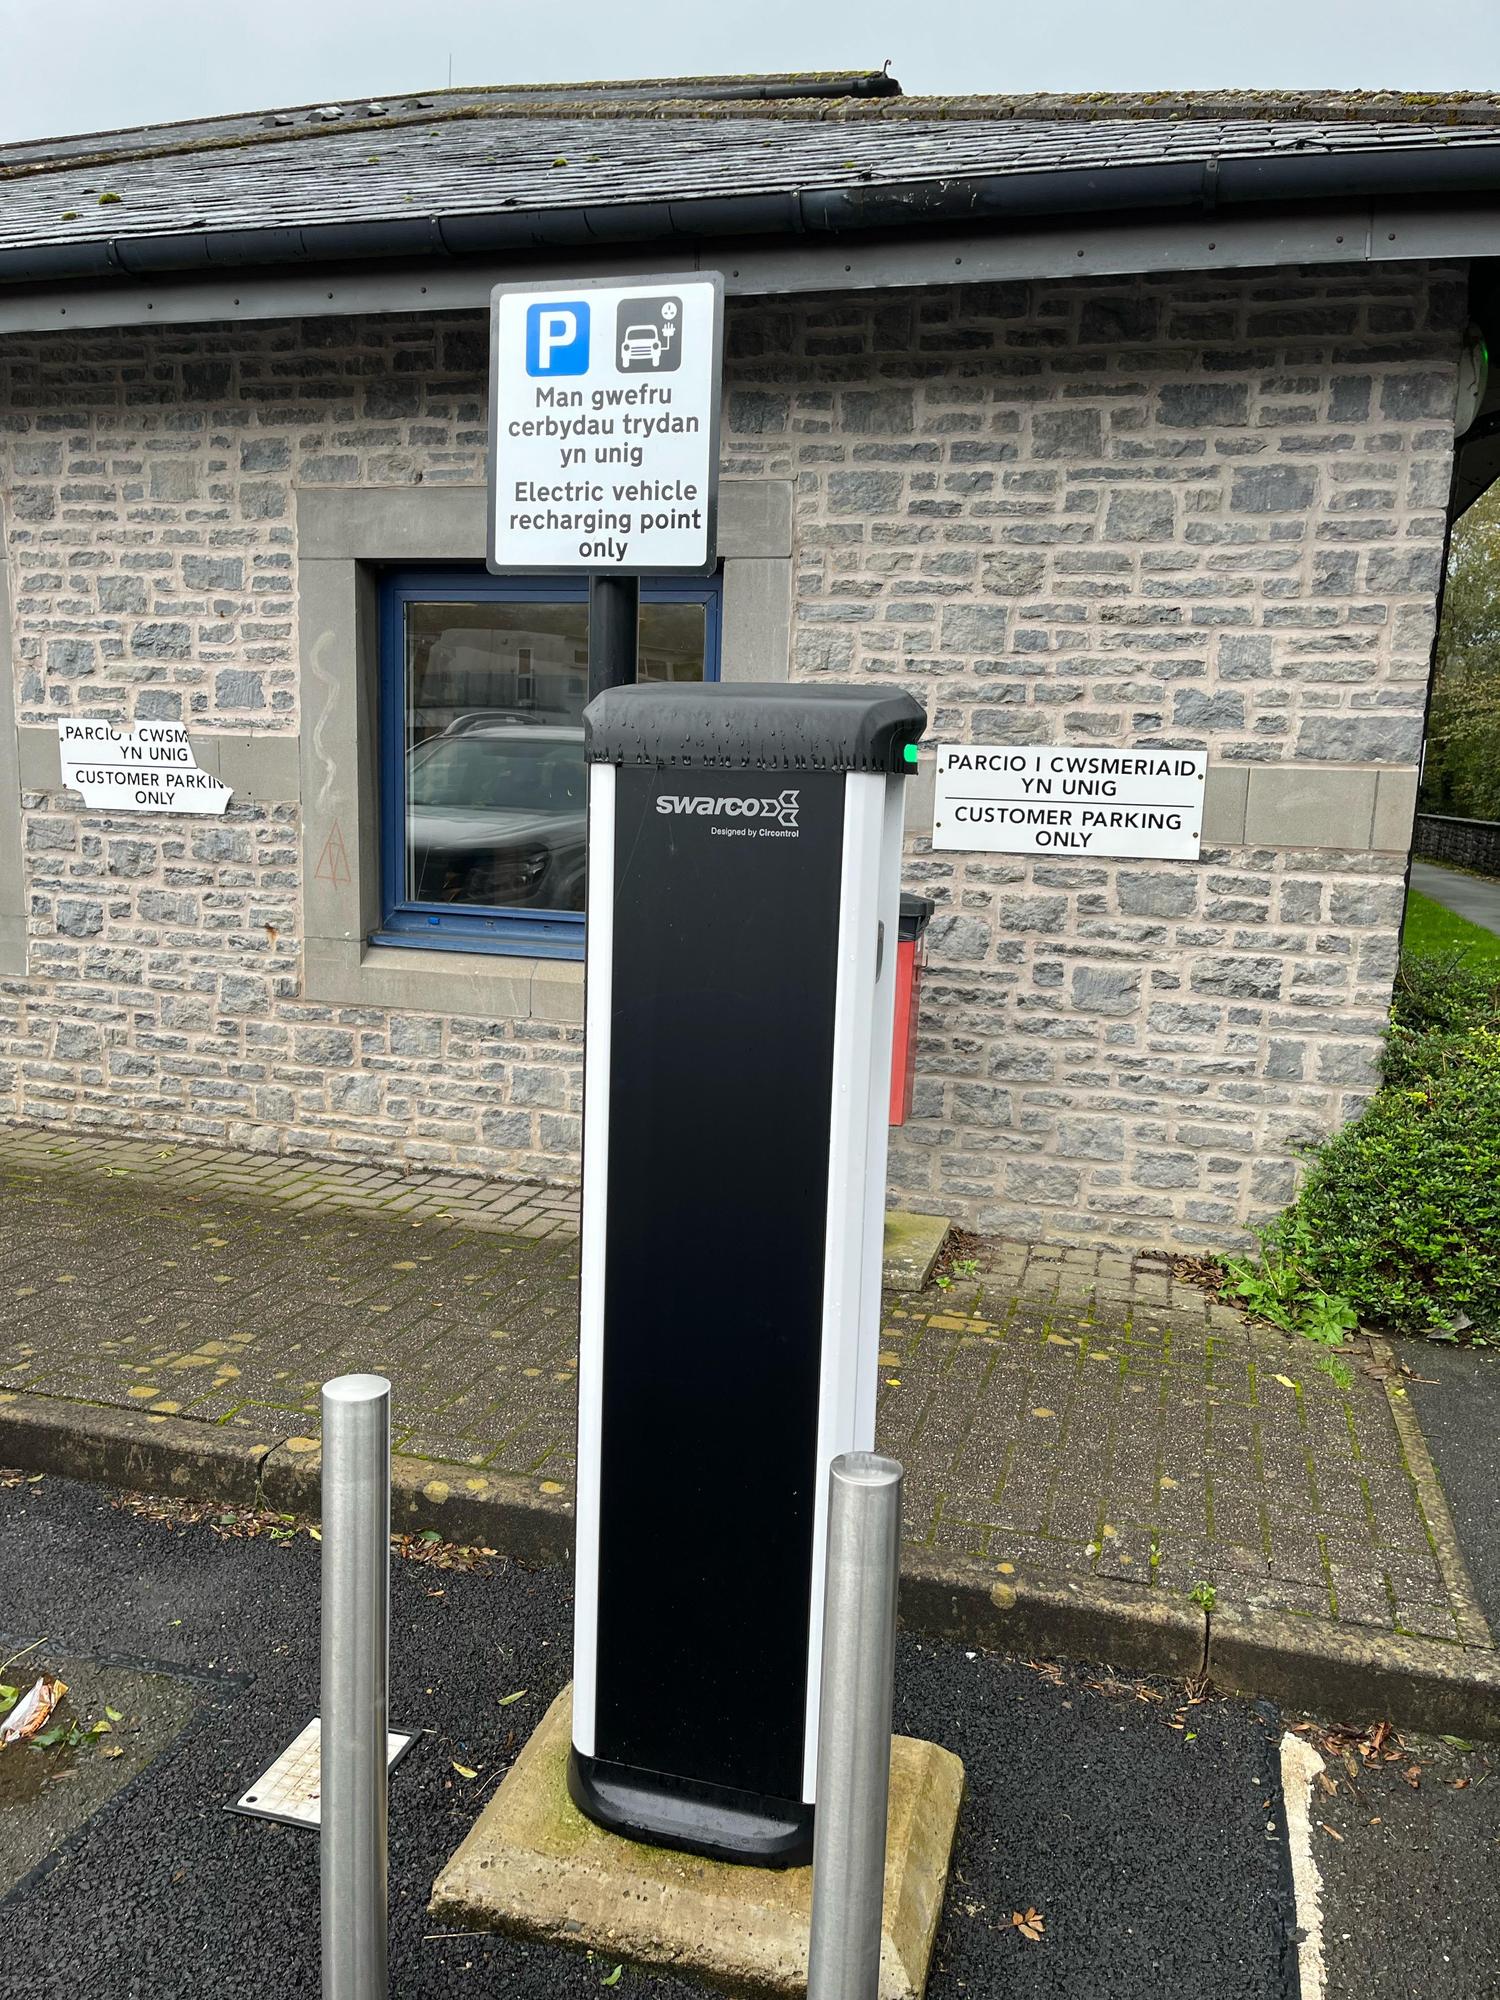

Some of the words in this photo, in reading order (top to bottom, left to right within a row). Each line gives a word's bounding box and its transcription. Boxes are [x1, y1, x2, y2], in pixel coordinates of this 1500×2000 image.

[538, 310, 577, 369] P
[536, 386, 583, 408] Man
[591, 383, 672, 410] gwefru
[508, 414, 614, 440] cerbydau
[622, 412, 699, 438] trydan
[560, 446, 586, 468] yn
[595, 442, 643, 467] unig
[515, 480, 604, 502] Electric
[612, 479, 698, 501] vehicle
[509, 509, 632, 533] recharging
[640, 508, 701, 533] point
[578, 537, 628, 562] only
[119, 745, 143, 760] YN
[149, 747, 188, 762] UNIG
[948, 754, 1027, 772] PARCIO
[1035, 756, 1041, 772] I
[1050, 756, 1196, 777] CWSMERIAID
[75, 770, 160, 787] CUSTOMER
[1021, 777, 1052, 795] YN
[1062, 779, 1117, 796] UNIG
[134, 791, 176, 806] ONLY
[655, 795, 761, 817] swarco
[954, 806, 1072, 826] CUSTOMER
[1081, 811, 1182, 830] PARKING
[711, 826, 746, 837] Designed
[747, 828, 758, 838] by
[758, 828, 800, 838] Circontrol
[1035, 830, 1093, 848] ONLY
